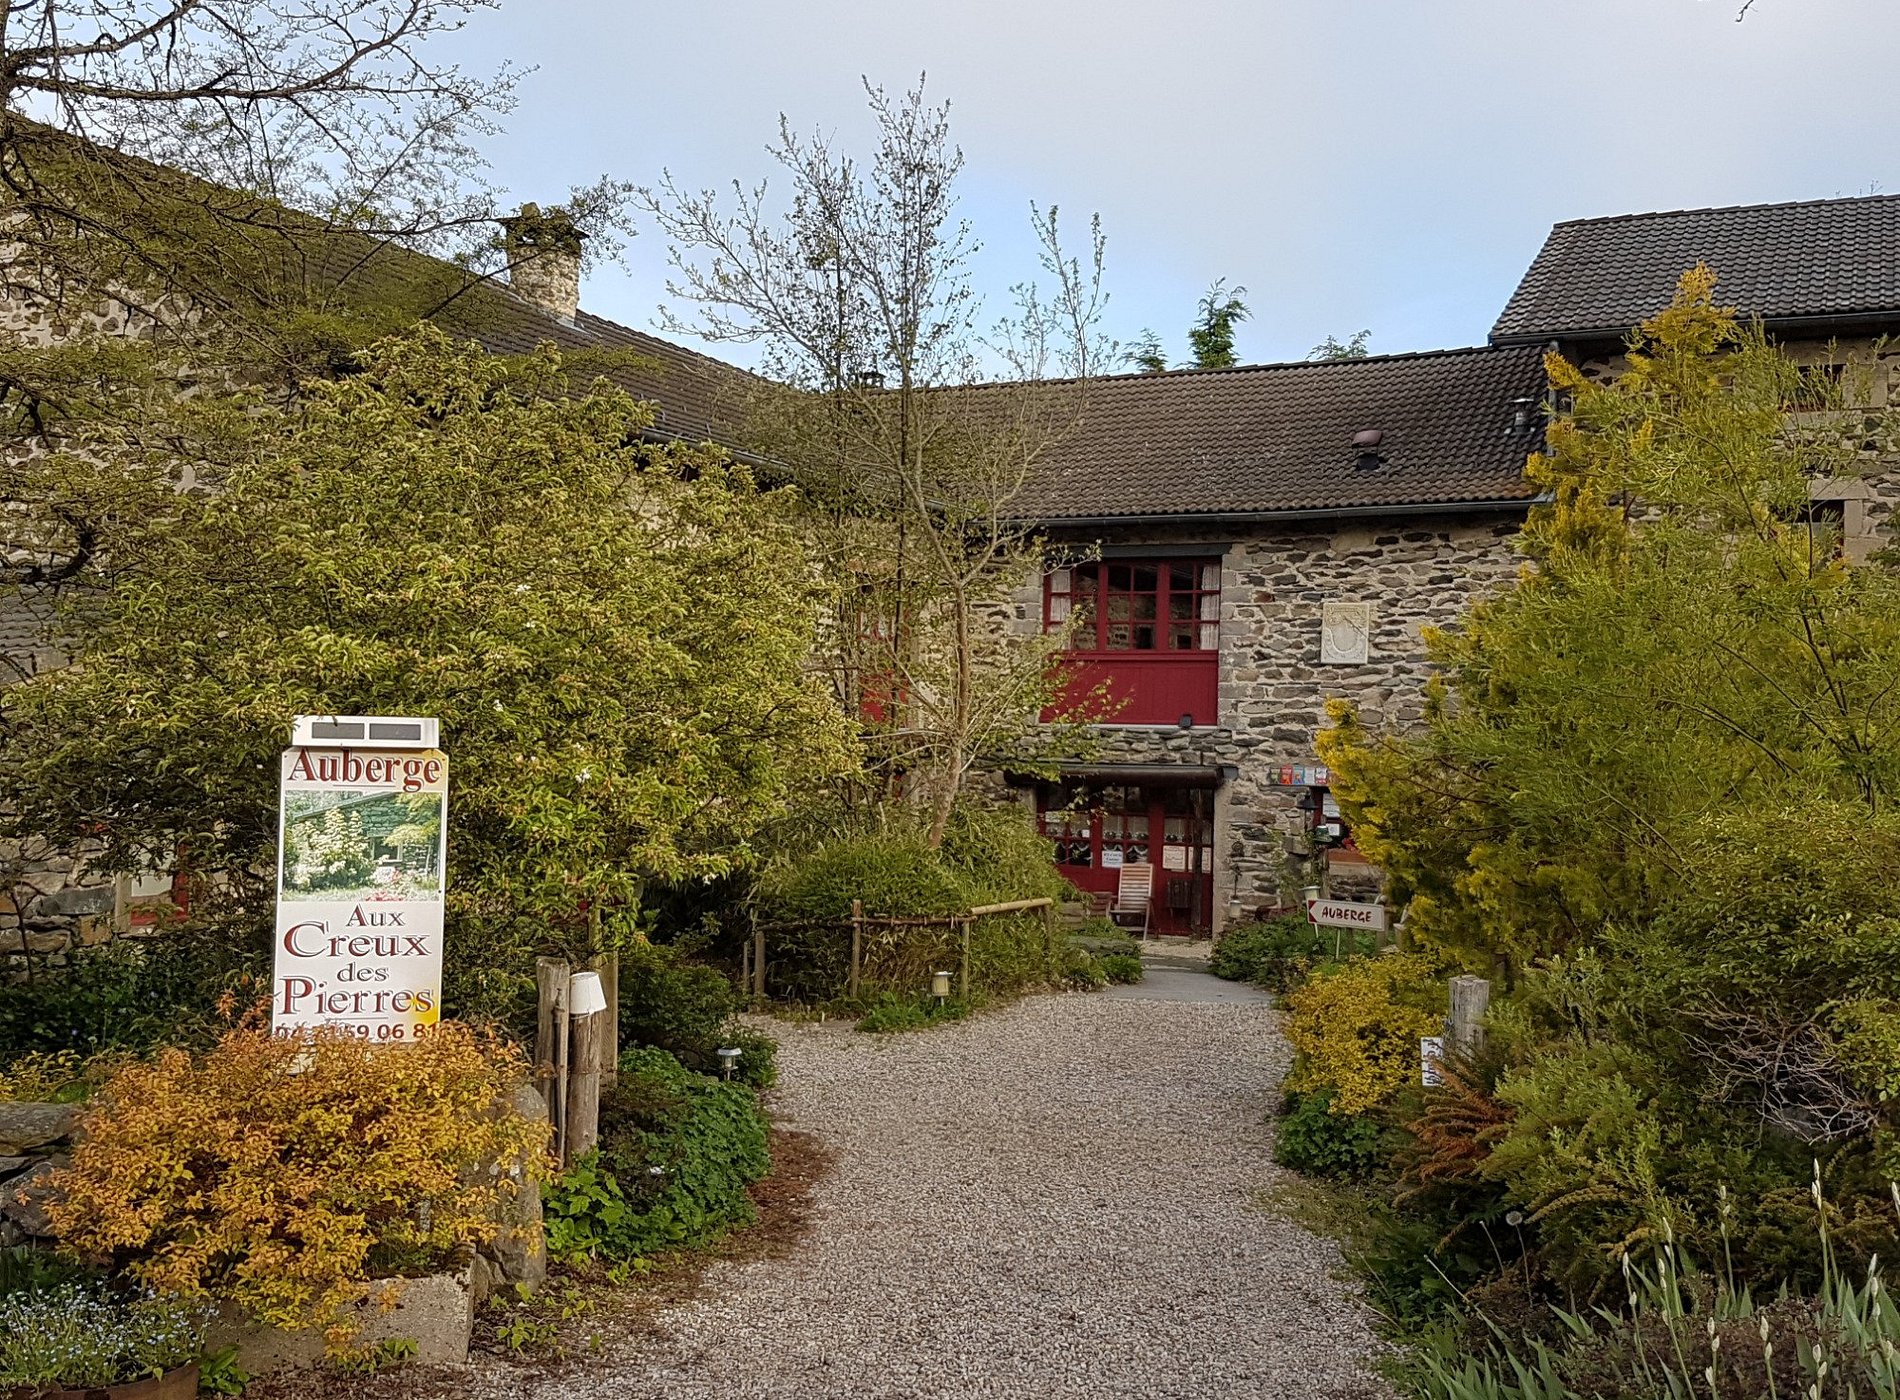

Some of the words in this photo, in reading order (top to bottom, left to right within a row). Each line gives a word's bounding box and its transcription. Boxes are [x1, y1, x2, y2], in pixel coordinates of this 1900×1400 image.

[287, 747, 442, 792] Auberge
[346, 904, 405, 927] Aux
[1321, 906, 1372, 923] AUBERGE
[283, 920, 431, 957] Creux
[336, 962, 389, 983] des
[277, 974, 435, 1016] Pierres
[377, 1023, 405, 1040] 06
